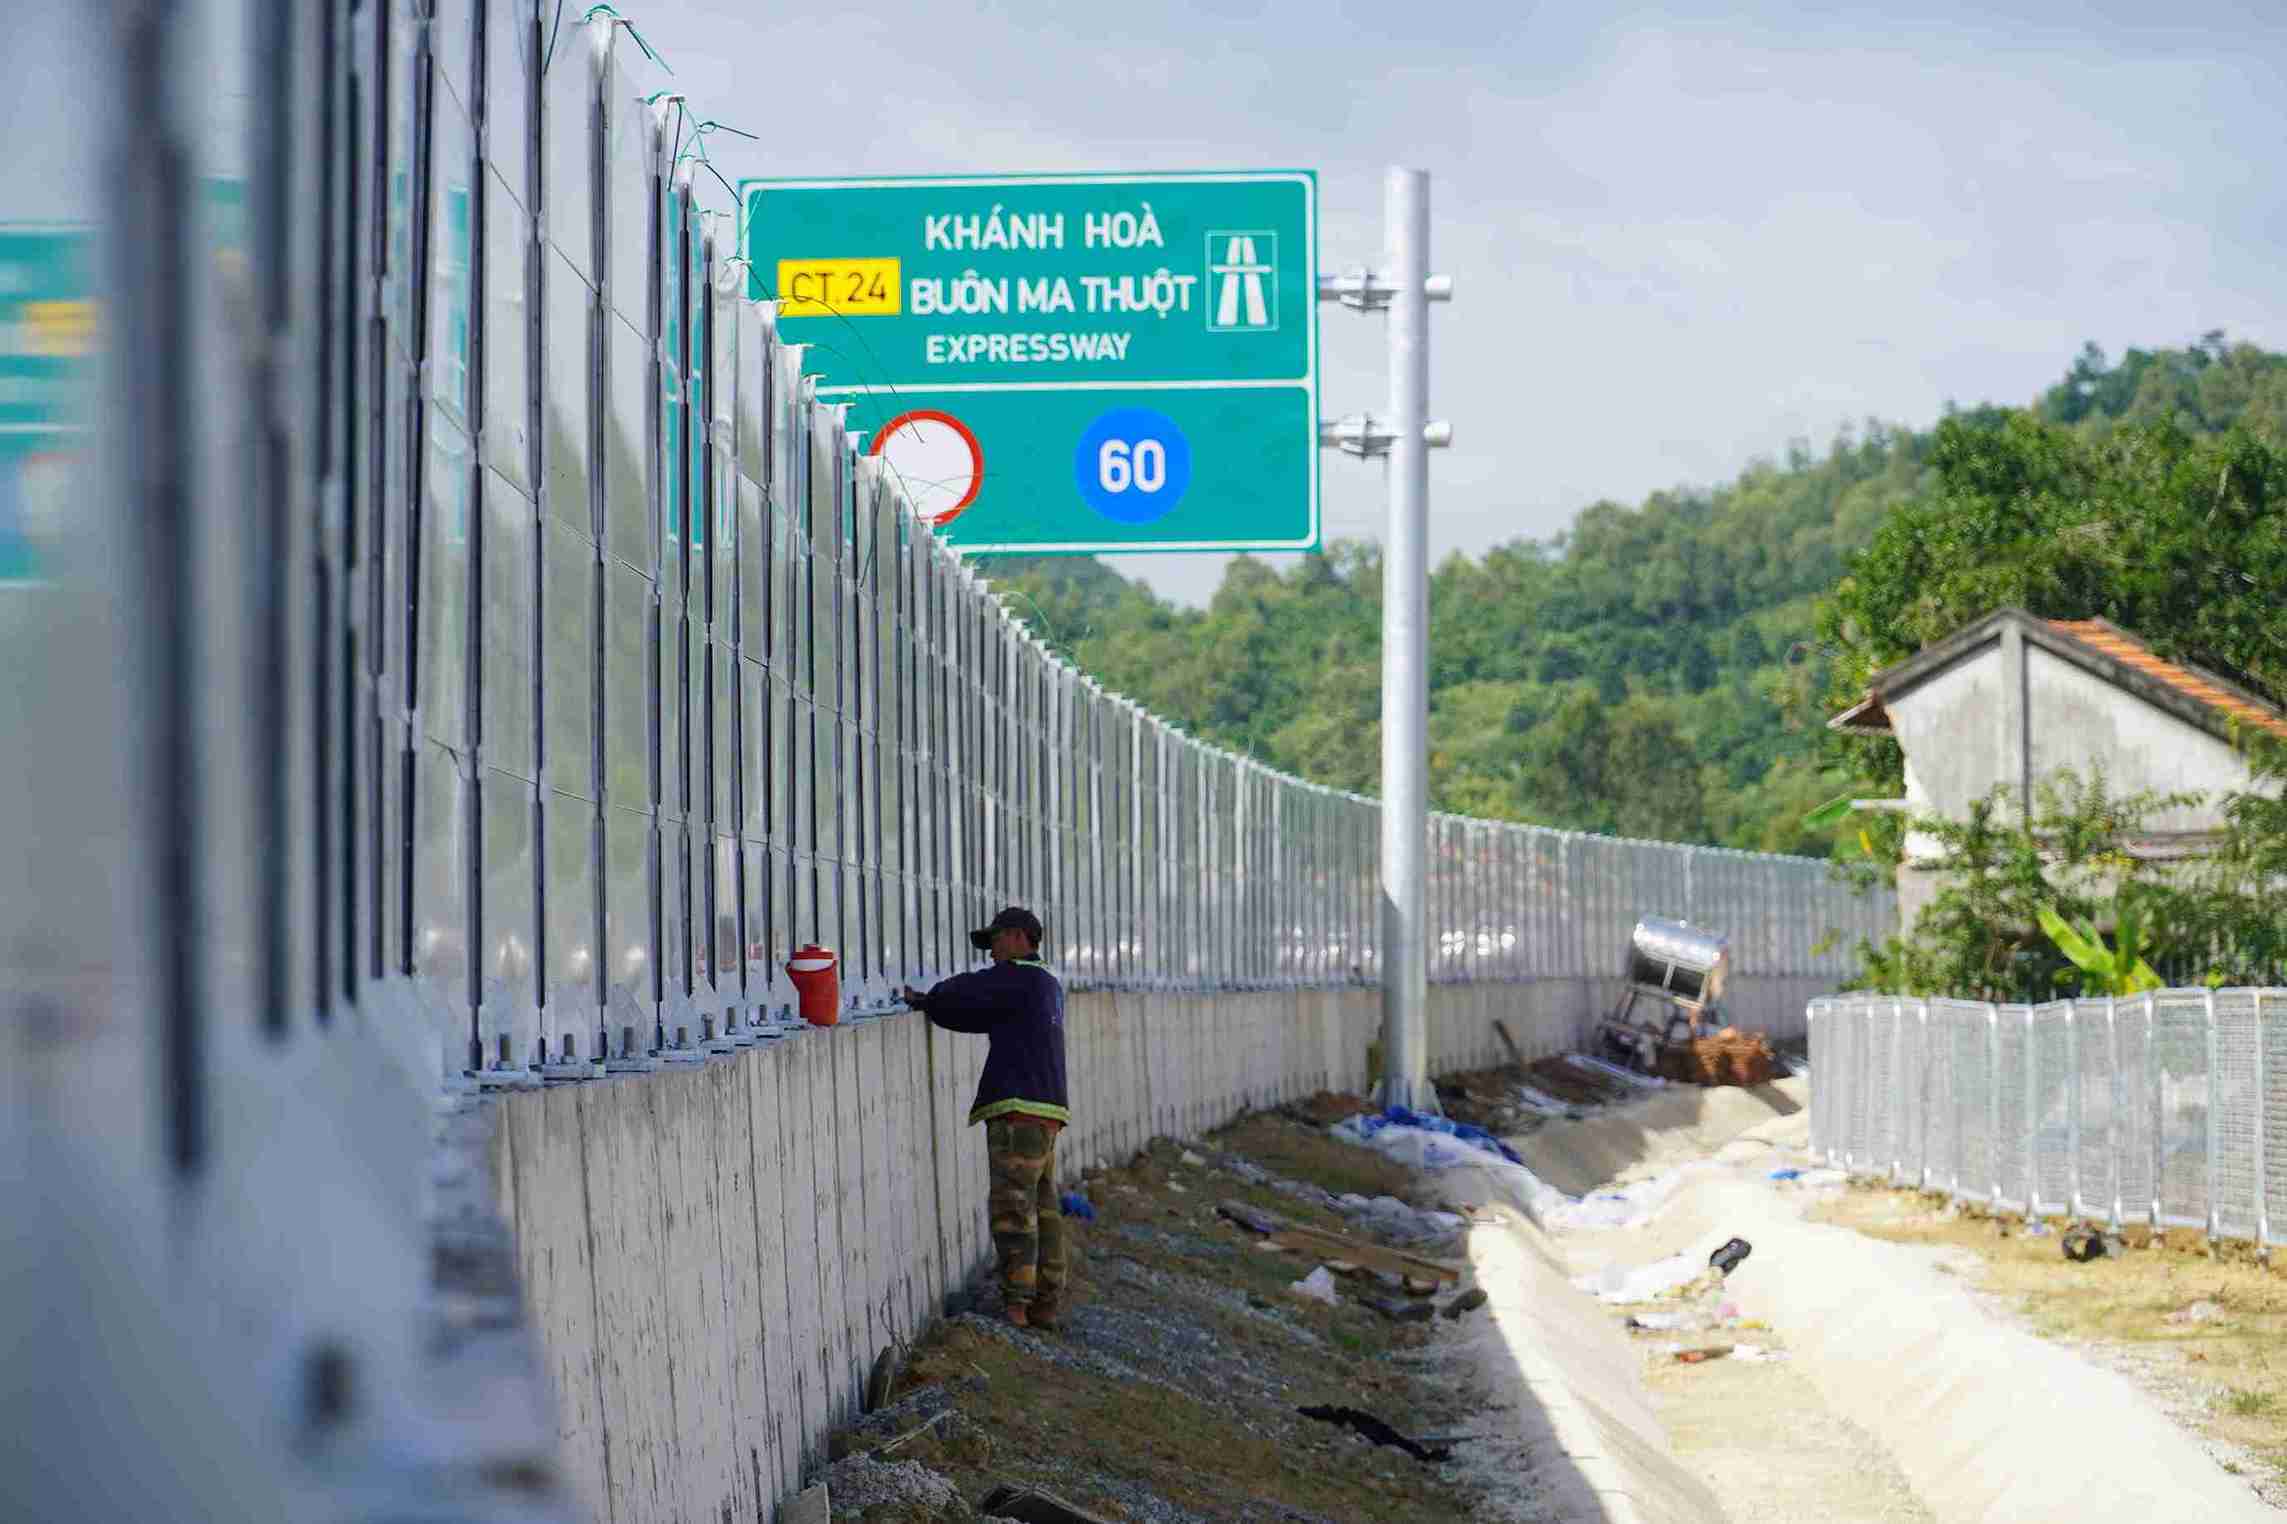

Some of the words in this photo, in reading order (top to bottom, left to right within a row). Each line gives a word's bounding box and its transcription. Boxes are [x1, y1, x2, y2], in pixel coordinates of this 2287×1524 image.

[925, 202, 1064, 250] KHÁNH
[1085, 201, 1164, 248] HOÀ
[910, 269, 1009, 315] BUÔN
[1017, 276, 1076, 313] MA
[1080, 267, 1198, 319] THUỘT
[926, 333, 1131, 363] EXPRESSWAY
[1099, 438, 1166, 493] 60
